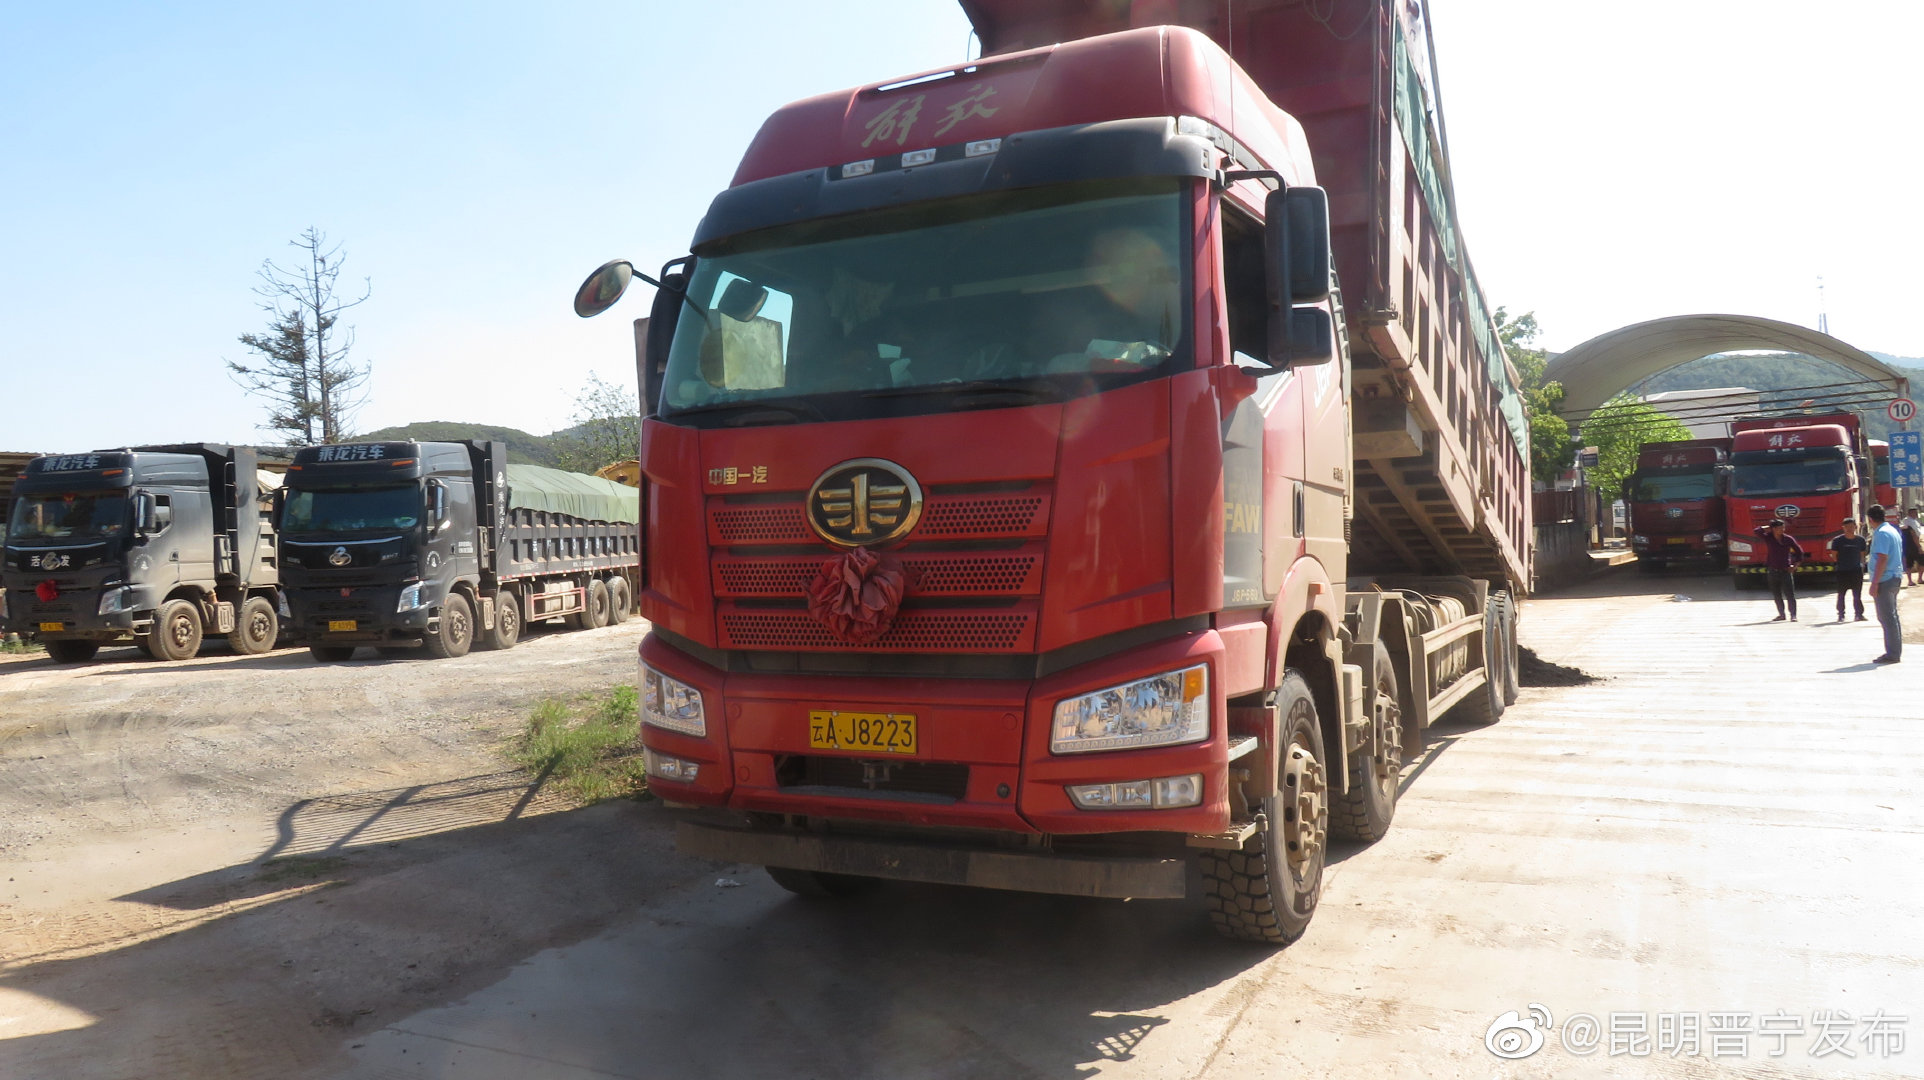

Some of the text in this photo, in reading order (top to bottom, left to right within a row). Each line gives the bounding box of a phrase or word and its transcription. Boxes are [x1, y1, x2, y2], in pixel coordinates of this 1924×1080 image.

[1893, 403, 1911, 417] 10
[1893, 435, 1907, 485] 交通安全
[708, 465, 768, 486] 中国一汽
[1223, 502, 1261, 534] FAW
